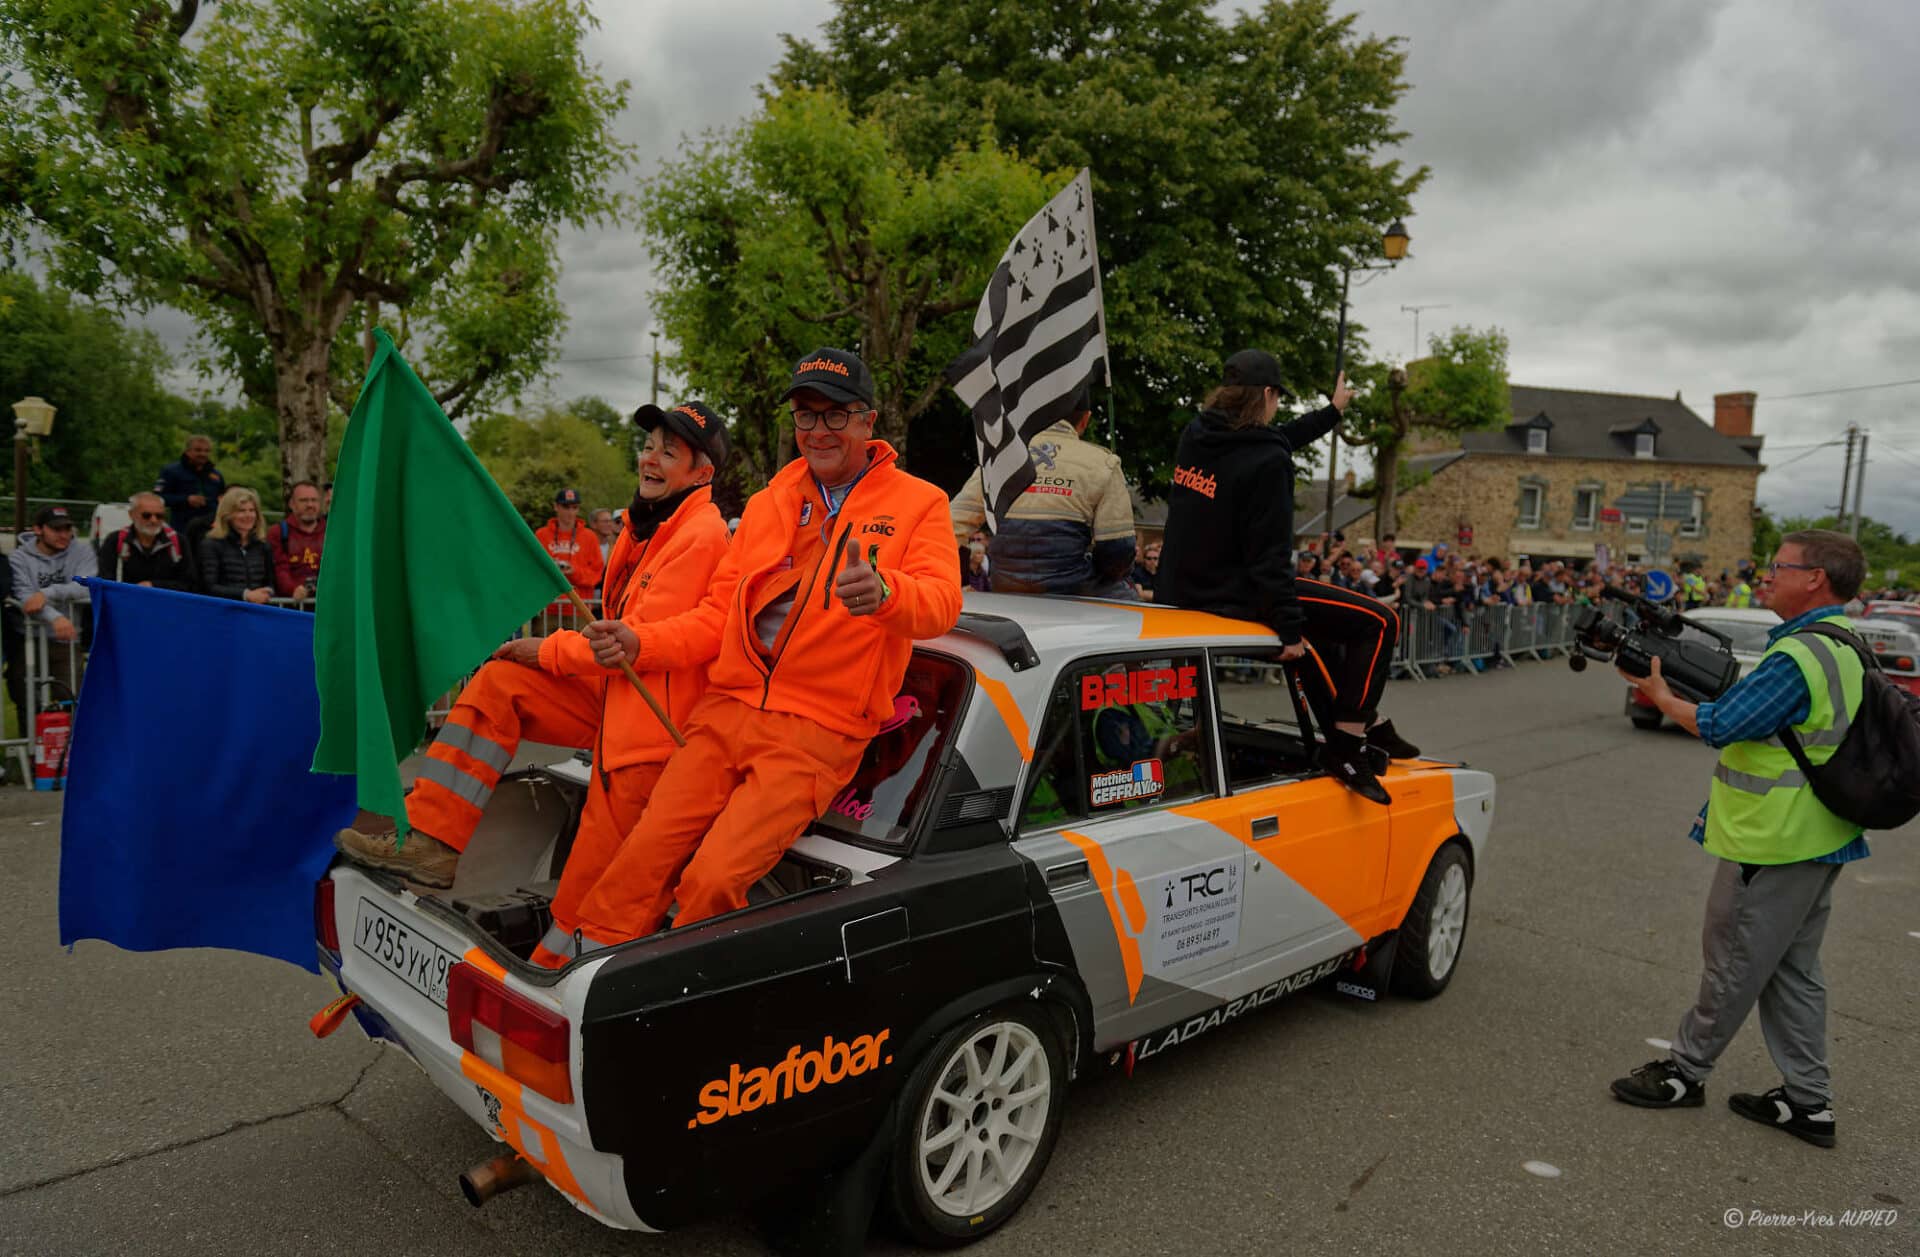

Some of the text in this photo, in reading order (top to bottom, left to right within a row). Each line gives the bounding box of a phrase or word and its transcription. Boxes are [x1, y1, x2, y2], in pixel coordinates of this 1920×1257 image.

[1081, 666, 1198, 711] BRIERE
[1092, 772, 1133, 788] Mathieu
[1180, 867, 1225, 902] TRC
